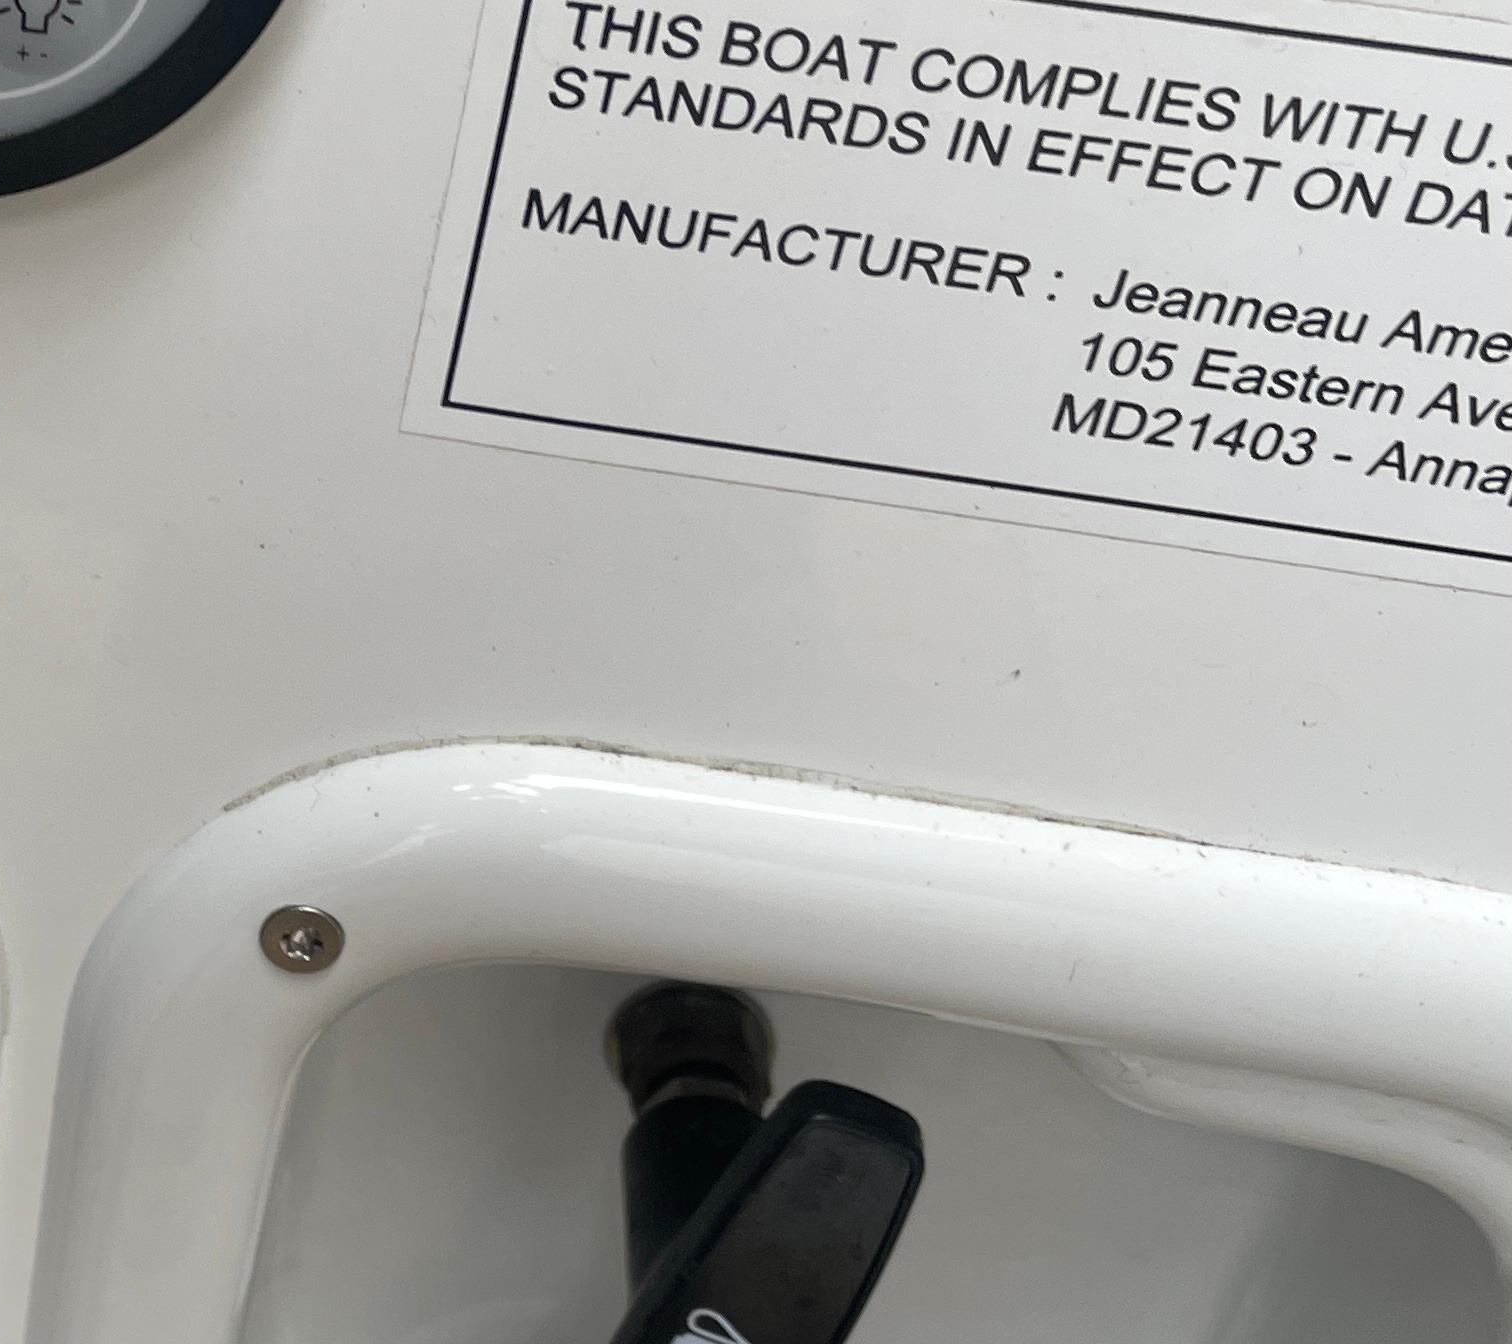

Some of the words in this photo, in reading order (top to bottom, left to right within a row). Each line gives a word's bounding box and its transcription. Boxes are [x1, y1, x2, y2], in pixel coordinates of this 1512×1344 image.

[548, 66, 930, 156] STANDARDS
[946, 116, 1012, 167] IN
[1026, 128, 1282, 202] EFFECT
[1292, 166, 1393, 219] ON
[565, 0, 703, 59] THIS
[719, 20, 898, 85] BOAT
[910, 47, 1241, 132] COMPLIES
[1262, 92, 1428, 158] WITH
[1443, 118, 1512, 171] U.
[521, 187, 1031, 298] MANUFACTURER
[1092, 269, 1369, 344] Jeanneau
[1052, 393, 1318, 467] MD21403
[1365, 439, 1512, 508] Anna
[1081, 332, 1179, 383] 105
[1190, 346, 1405, 417] Eastern
